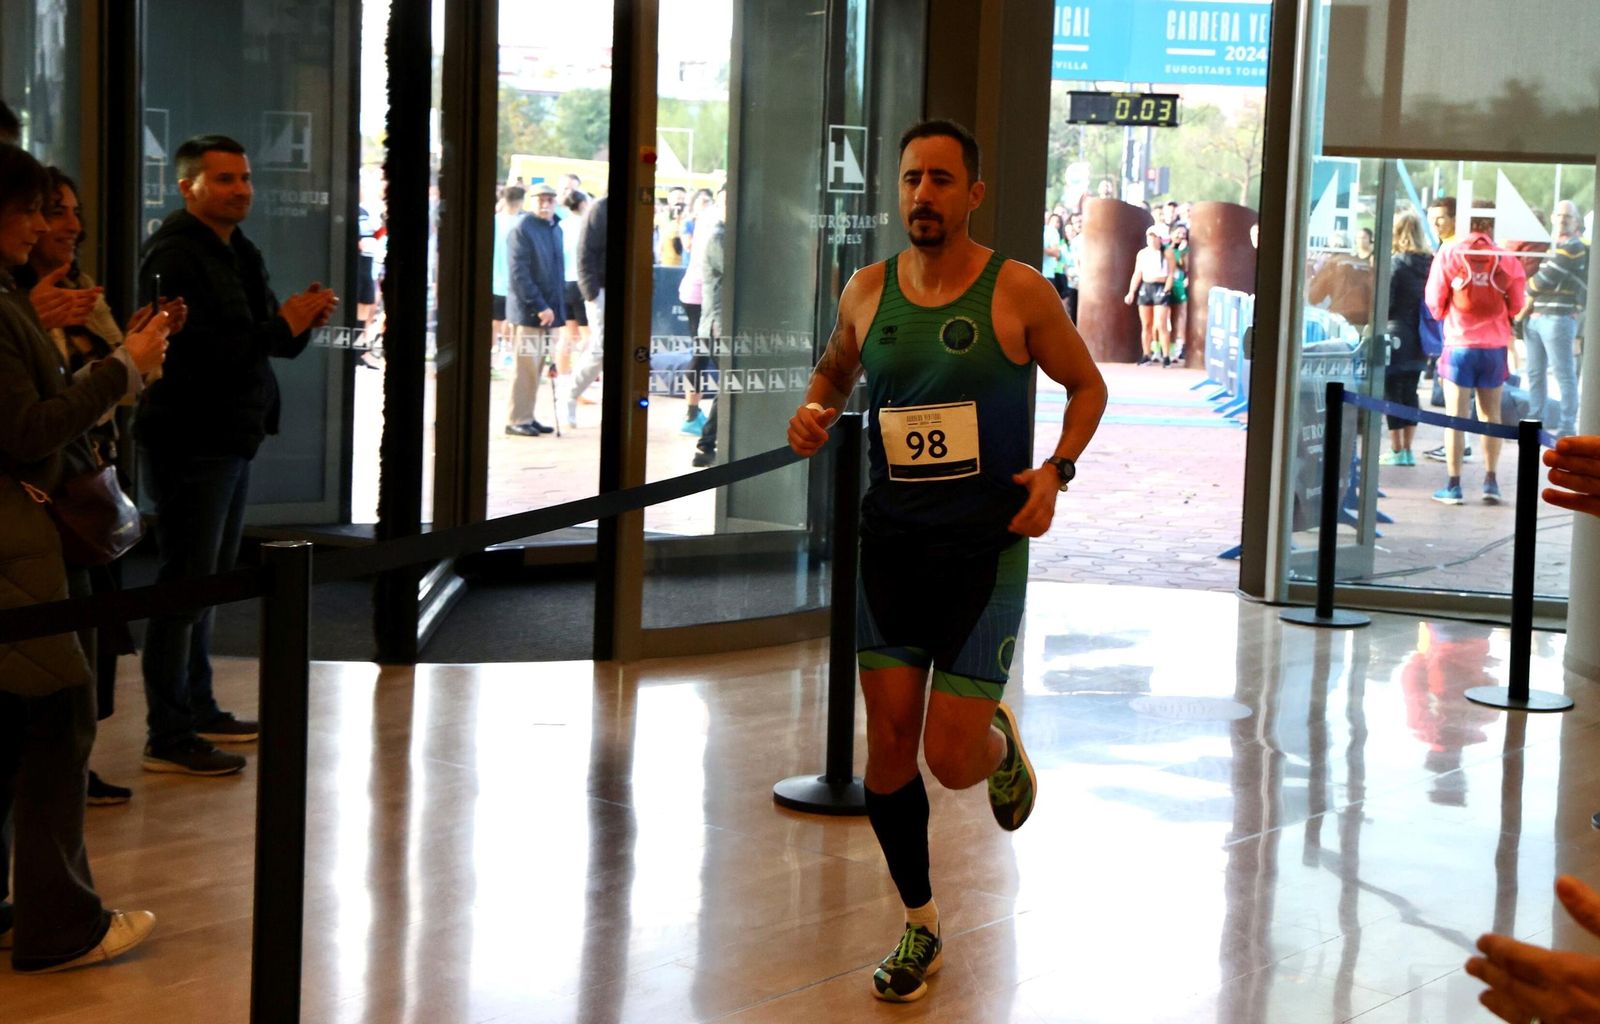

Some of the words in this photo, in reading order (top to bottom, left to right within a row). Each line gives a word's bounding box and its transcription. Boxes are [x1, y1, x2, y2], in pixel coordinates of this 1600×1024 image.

[1167, 9, 1240, 42] CARRERA
[1249, 12, 1268, 43] VE
[1223, 45, 1268, 62] 2024
[1055, 60, 1088, 70] VILLA
[1165, 64, 1232, 76] EUROSTARS
[827, 233, 862, 245] HOTELS
[906, 430, 948, 461] 98
